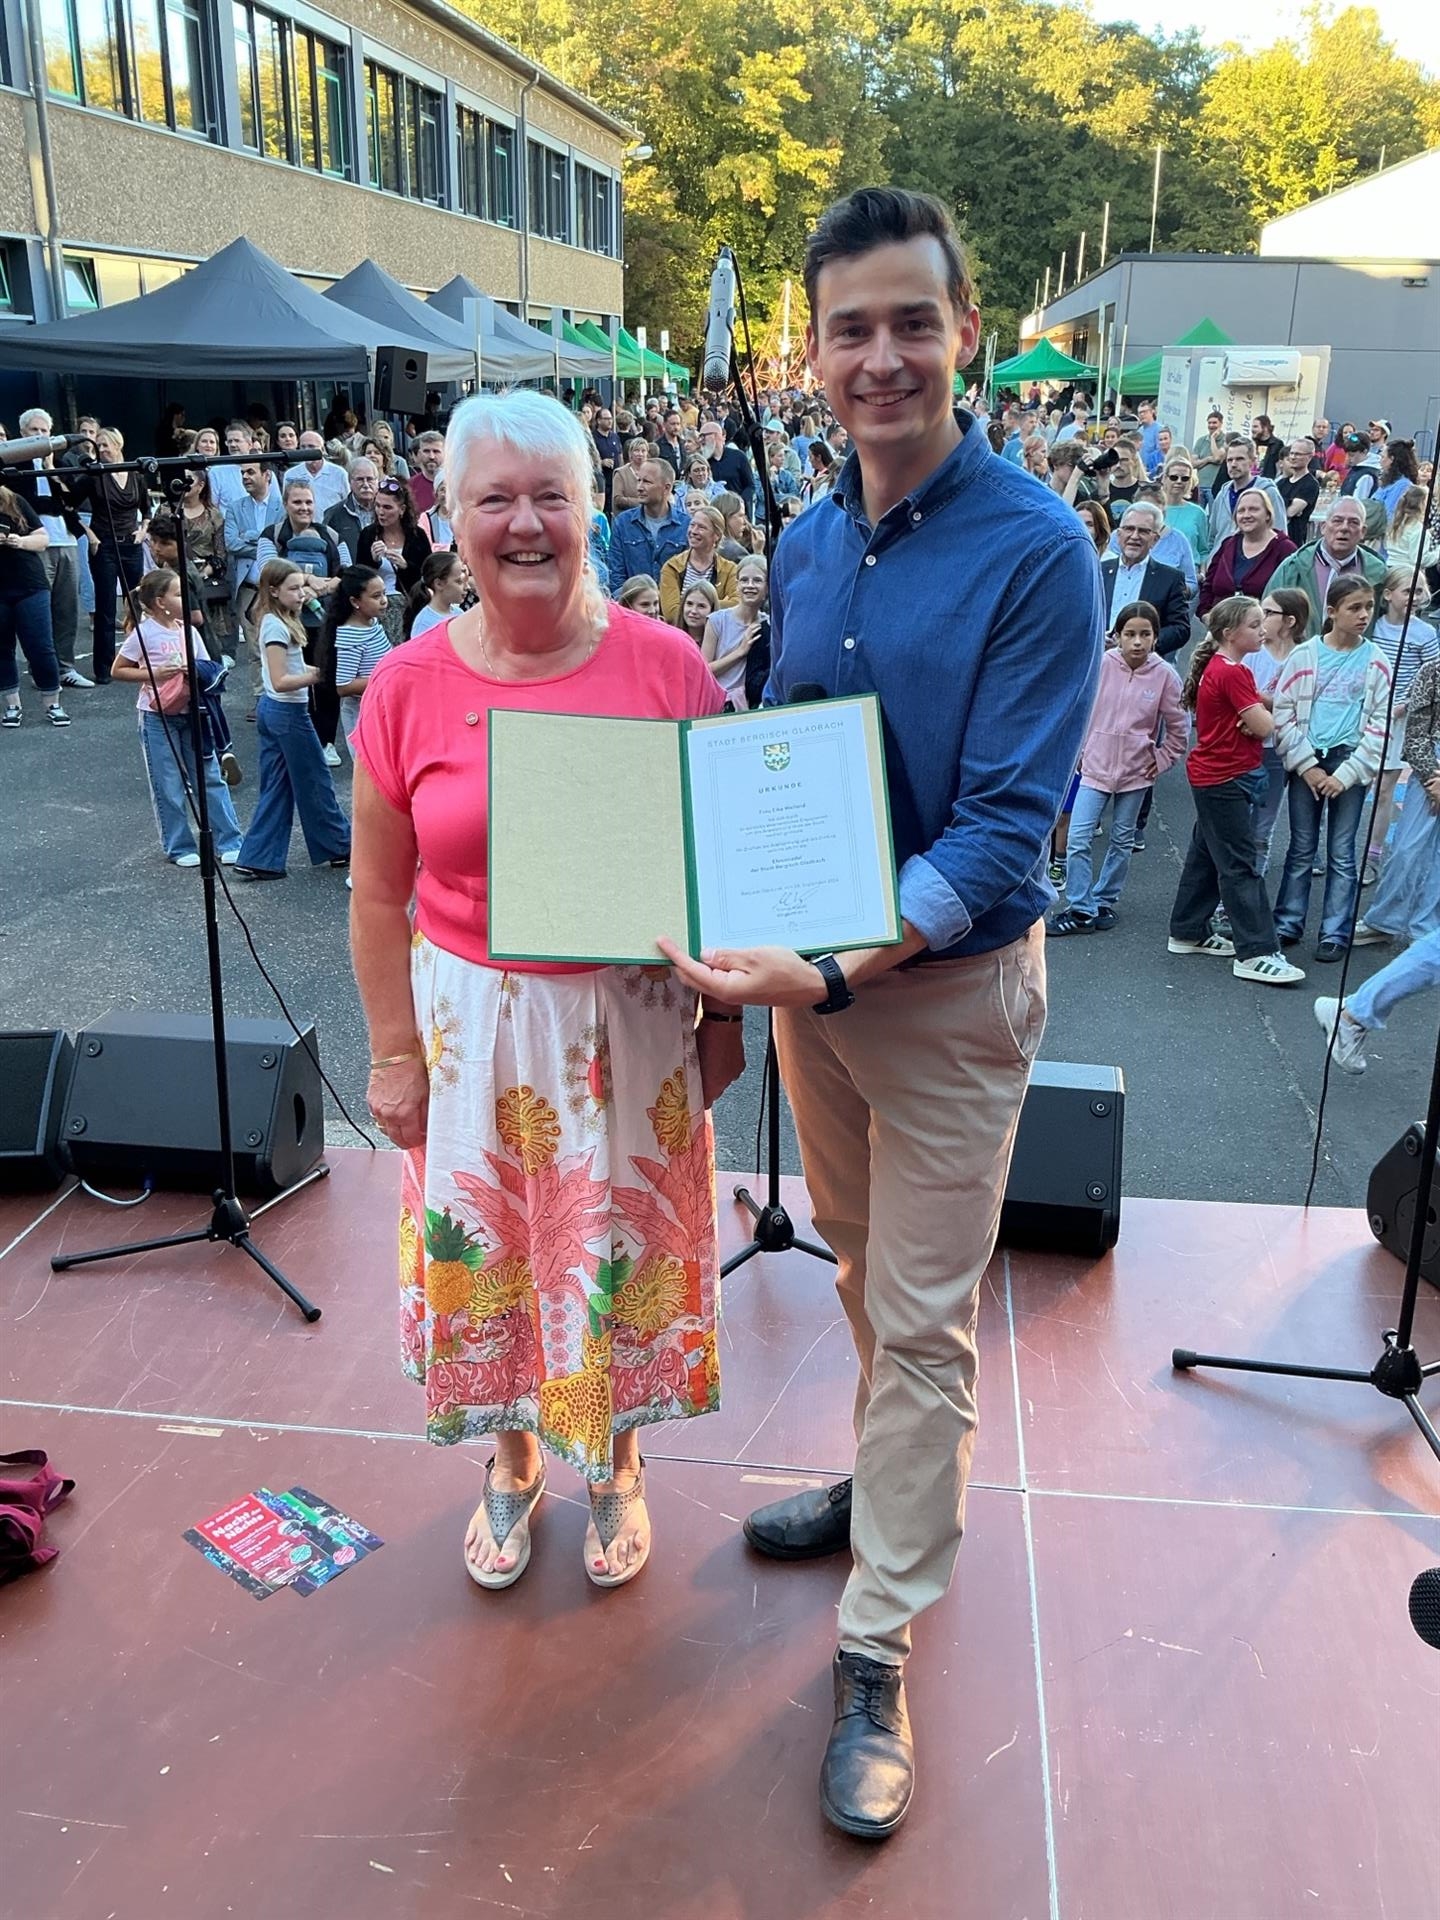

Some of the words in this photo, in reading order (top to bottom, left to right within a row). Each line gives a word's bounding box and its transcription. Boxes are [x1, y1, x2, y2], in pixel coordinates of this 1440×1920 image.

[707, 737, 736, 748] STADT
[740, 730, 788, 743] BERGISCH
[792, 721, 844, 735] GLADBACH
[758, 782, 802, 794] URKUNDE
[211, 1511, 250, 1538] Nacht
